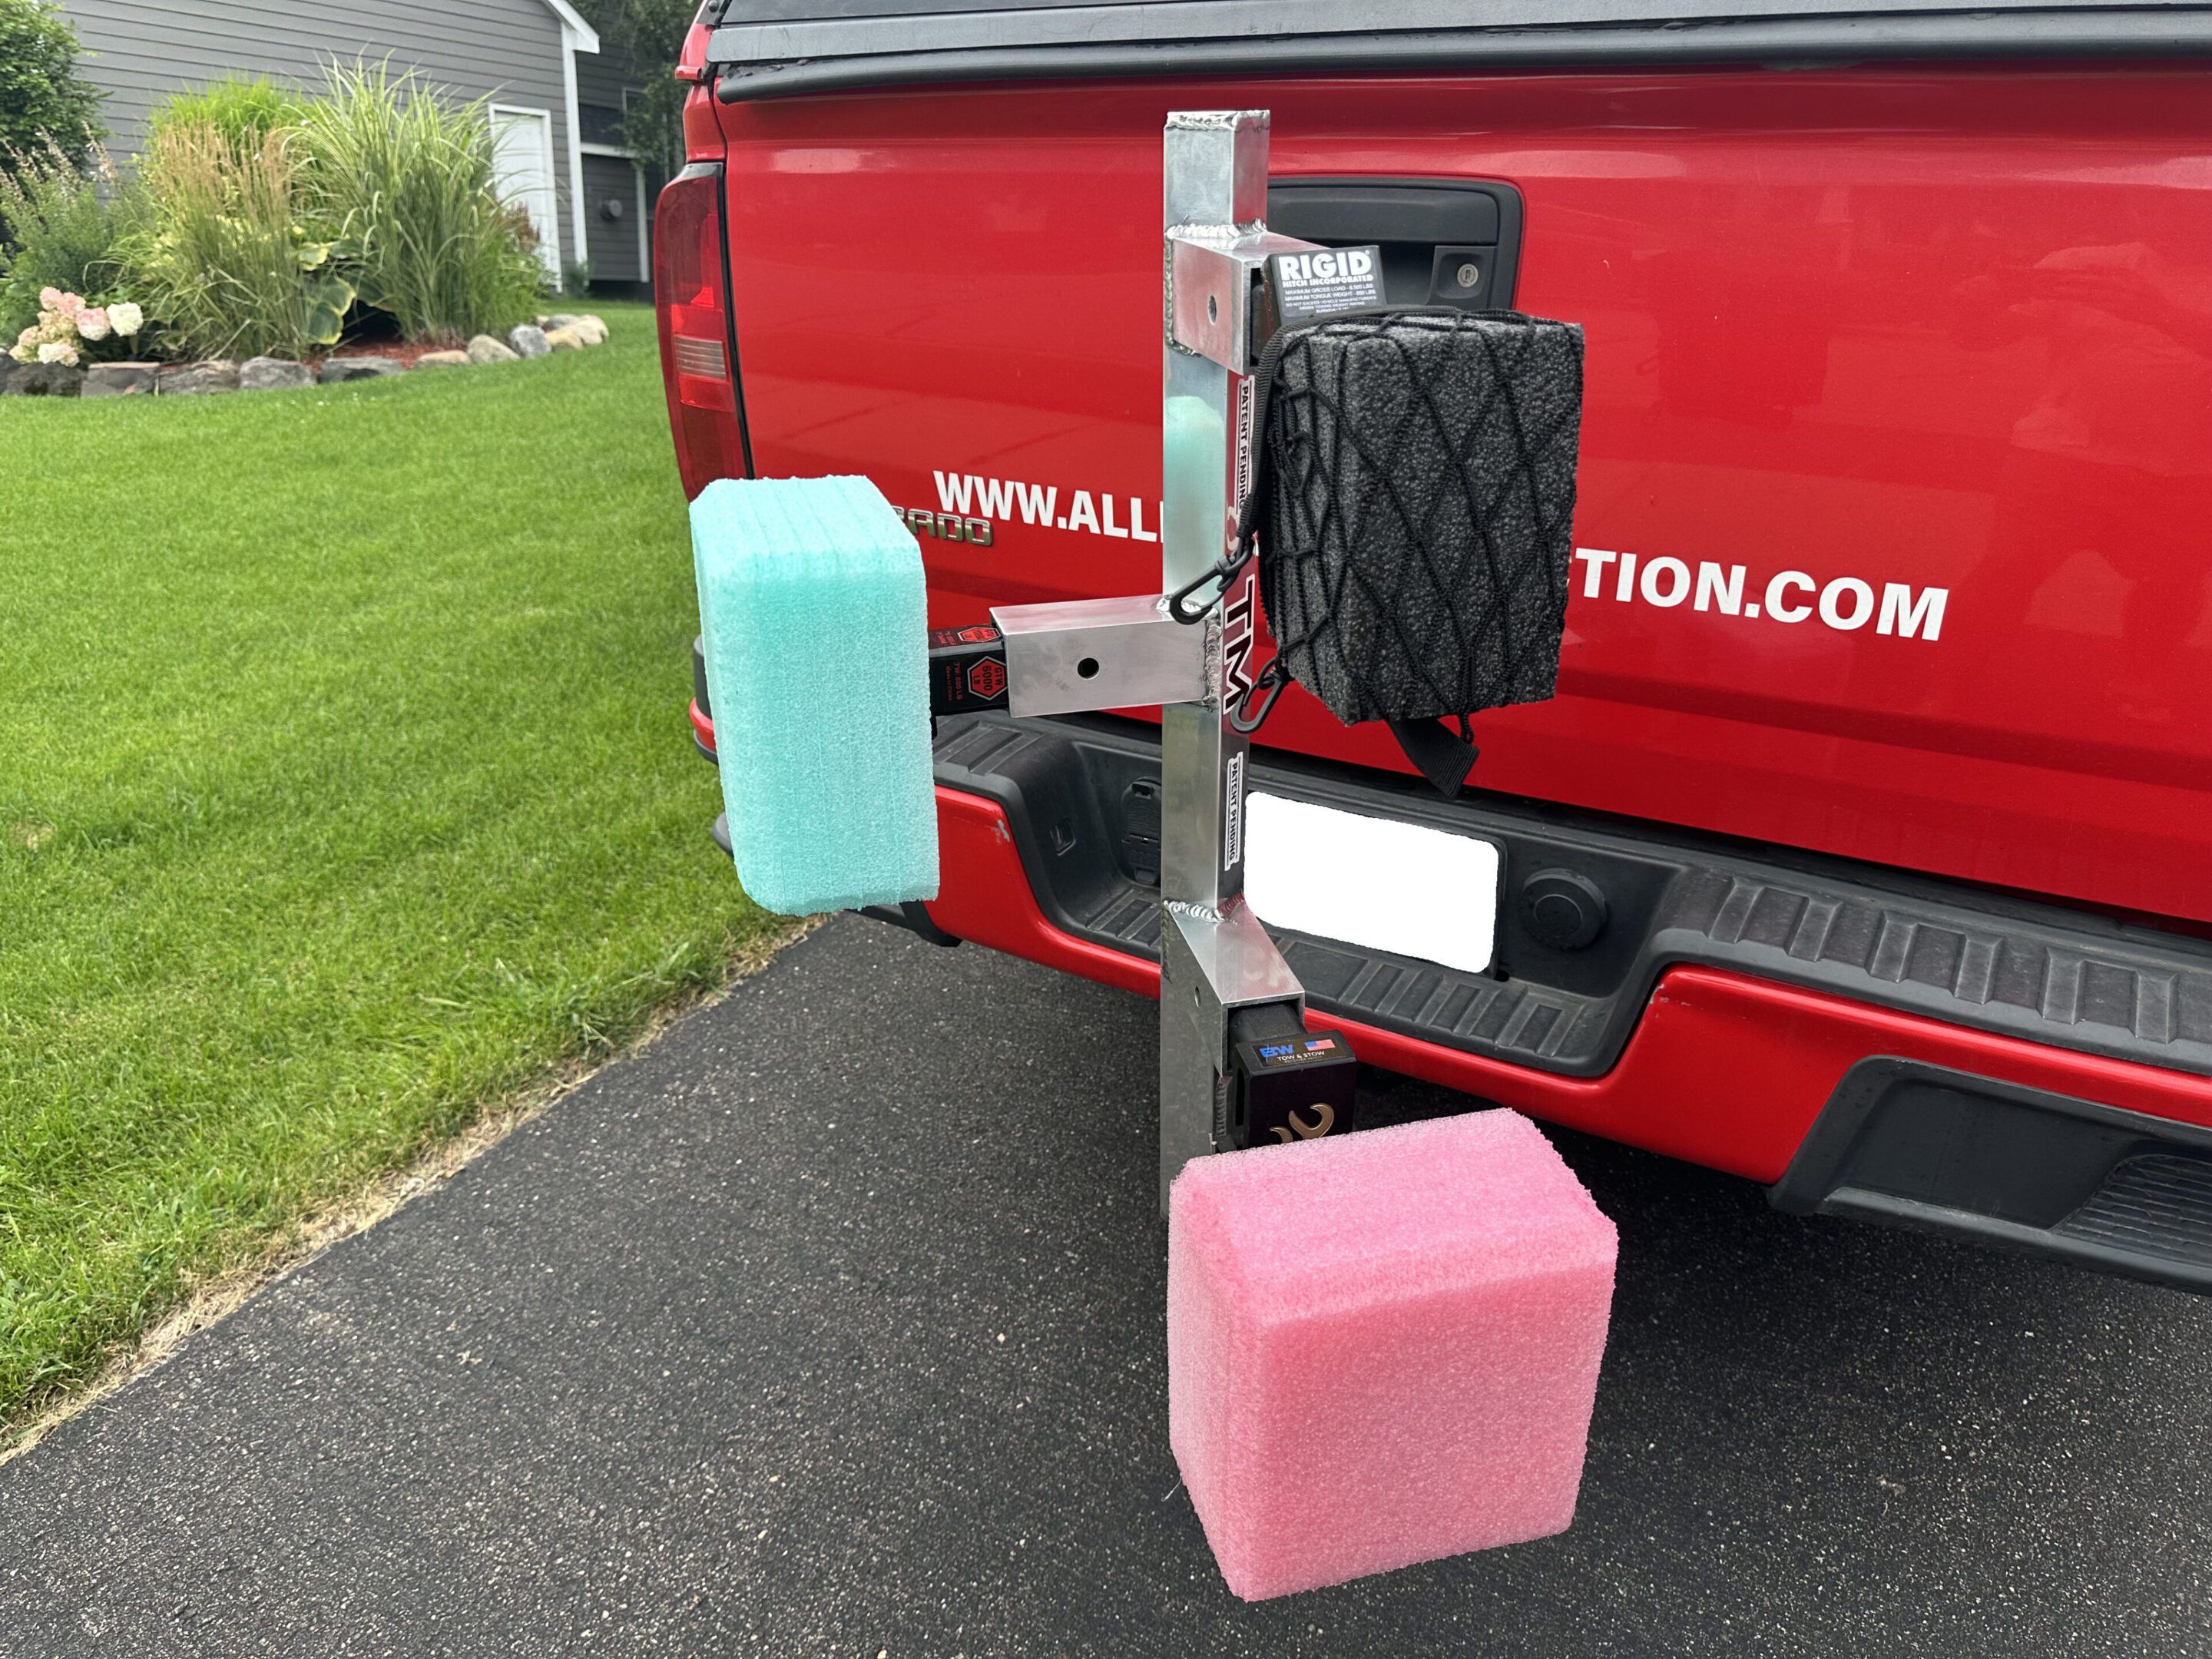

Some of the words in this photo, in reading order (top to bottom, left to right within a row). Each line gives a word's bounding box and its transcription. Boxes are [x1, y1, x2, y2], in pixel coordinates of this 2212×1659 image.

[1278, 251, 1372, 280] RIGID
[1283, 279, 1307, 287] HITCH
[1310, 274, 1374, 286] INCORPORATED
[1240, 386, 1249, 441] PATENT
[933, 470, 1163, 543] WWW.ALL
[1575, 548, 1949, 641] TION.COM
[973, 674, 981, 685] LB
[982, 665, 992, 690] 6000
[995, 667, 1003, 686] GTW
[956, 690, 963, 700] LB
